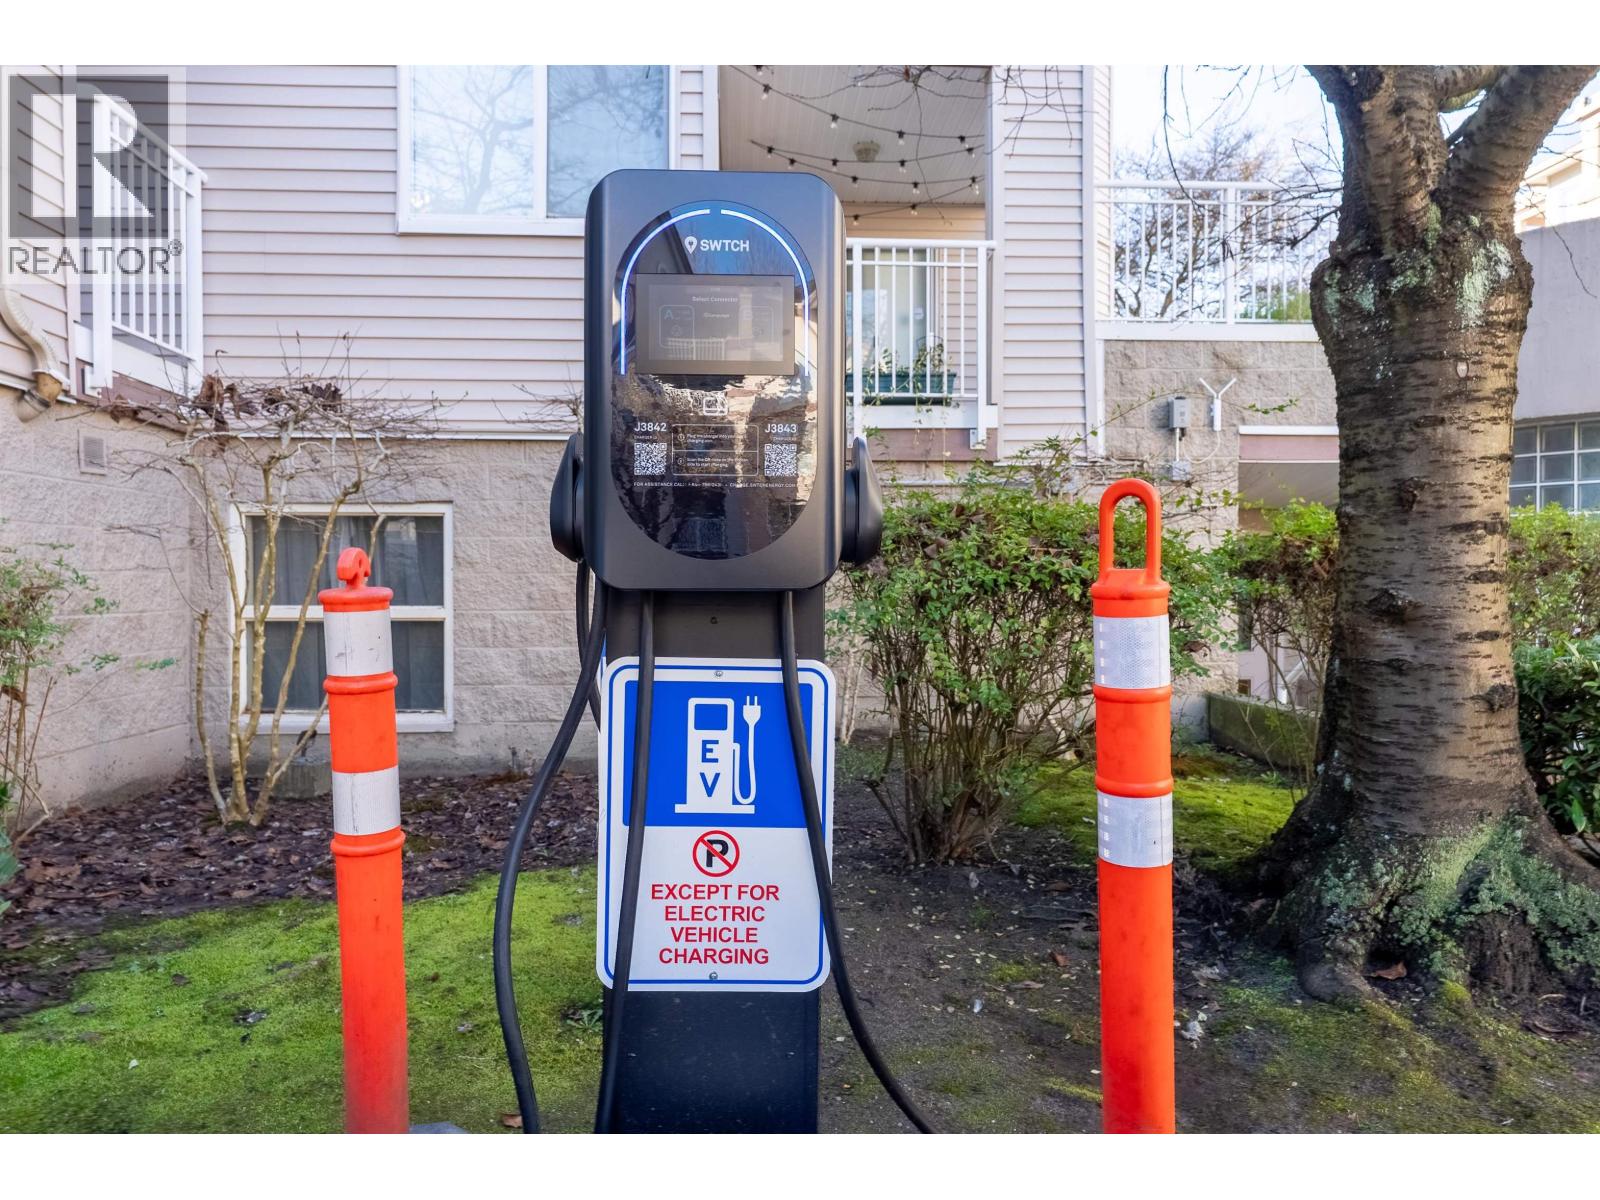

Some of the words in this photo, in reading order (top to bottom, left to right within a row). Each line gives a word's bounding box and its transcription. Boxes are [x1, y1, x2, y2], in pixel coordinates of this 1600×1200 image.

[700, 239, 750, 252] SWTCH
[634, 422, 667, 432] J3842
[764, 423, 797, 433] J3843
[651, 883, 733, 901] EXCEPT
[737, 884, 779, 901] FOR
[664, 905, 766, 922] ELECTRIC
[670, 927, 759, 943] VEHICLE
[659, 947, 770, 965] CHARGING
